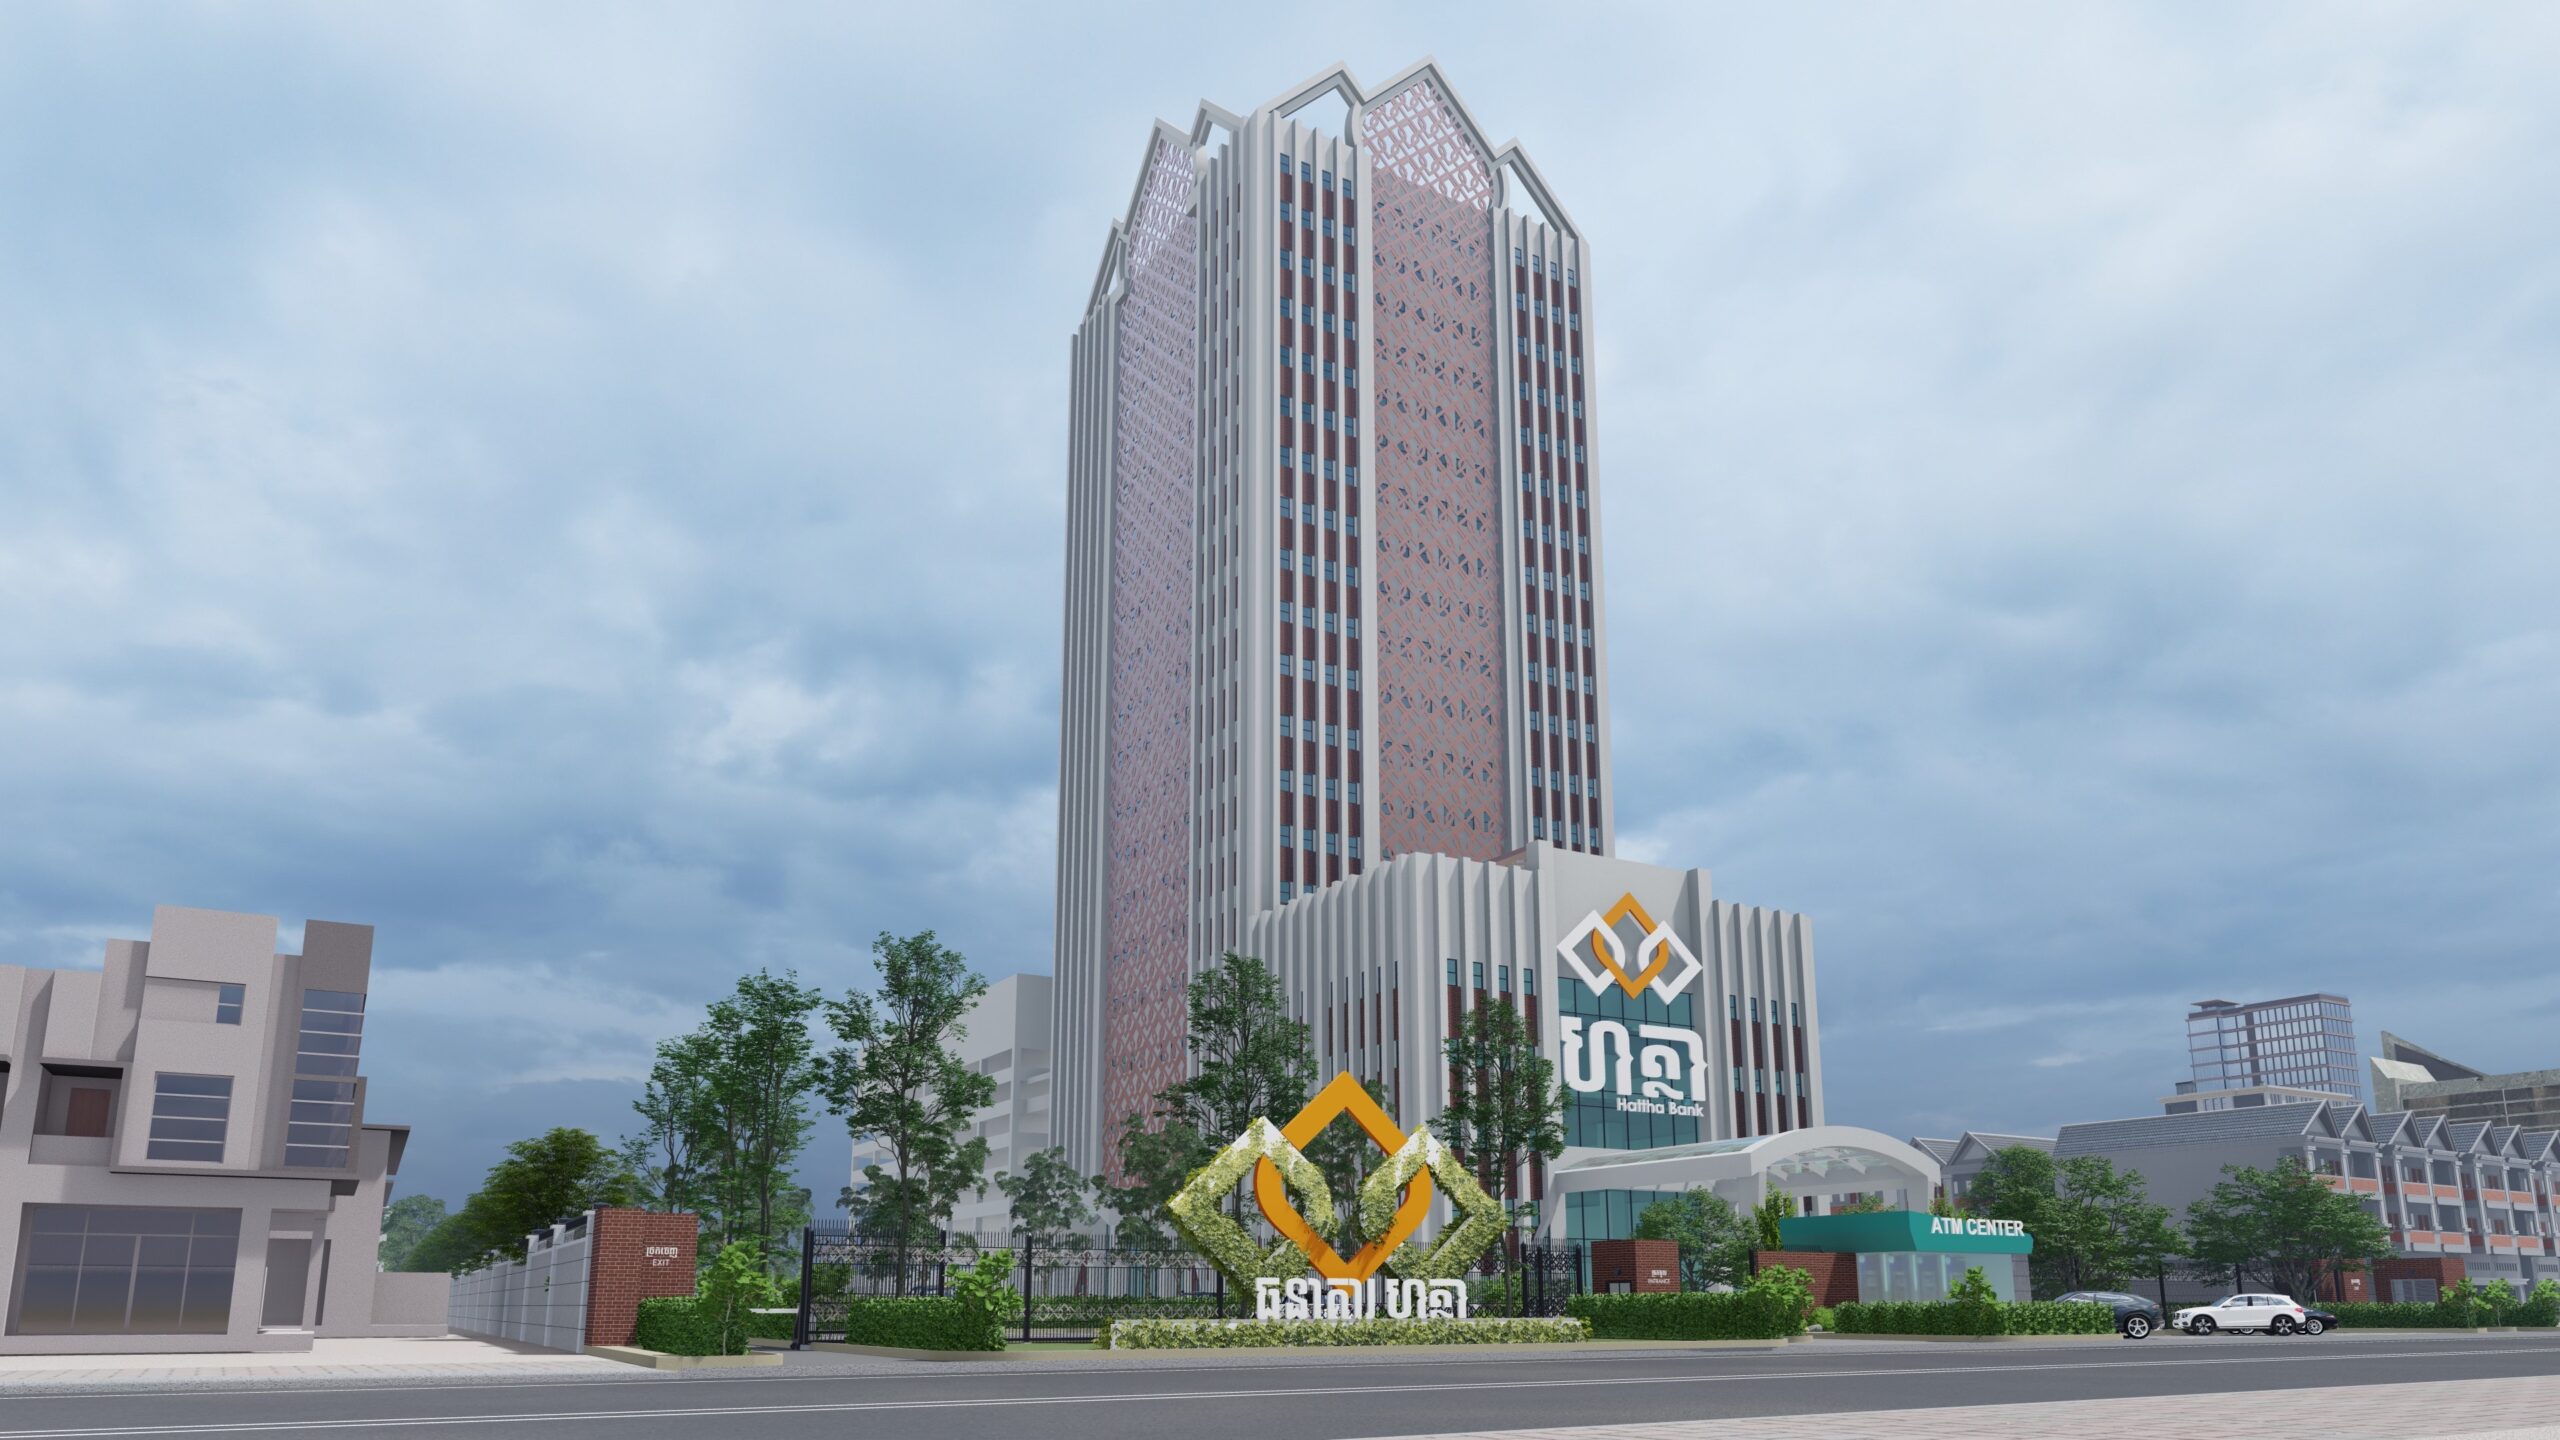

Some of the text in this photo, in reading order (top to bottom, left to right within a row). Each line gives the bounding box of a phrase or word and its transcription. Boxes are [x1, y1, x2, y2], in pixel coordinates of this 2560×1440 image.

[1616, 1097, 1704, 1117] Hattha Bank
[1930, 1217, 2025, 1236] ATM CENTER
